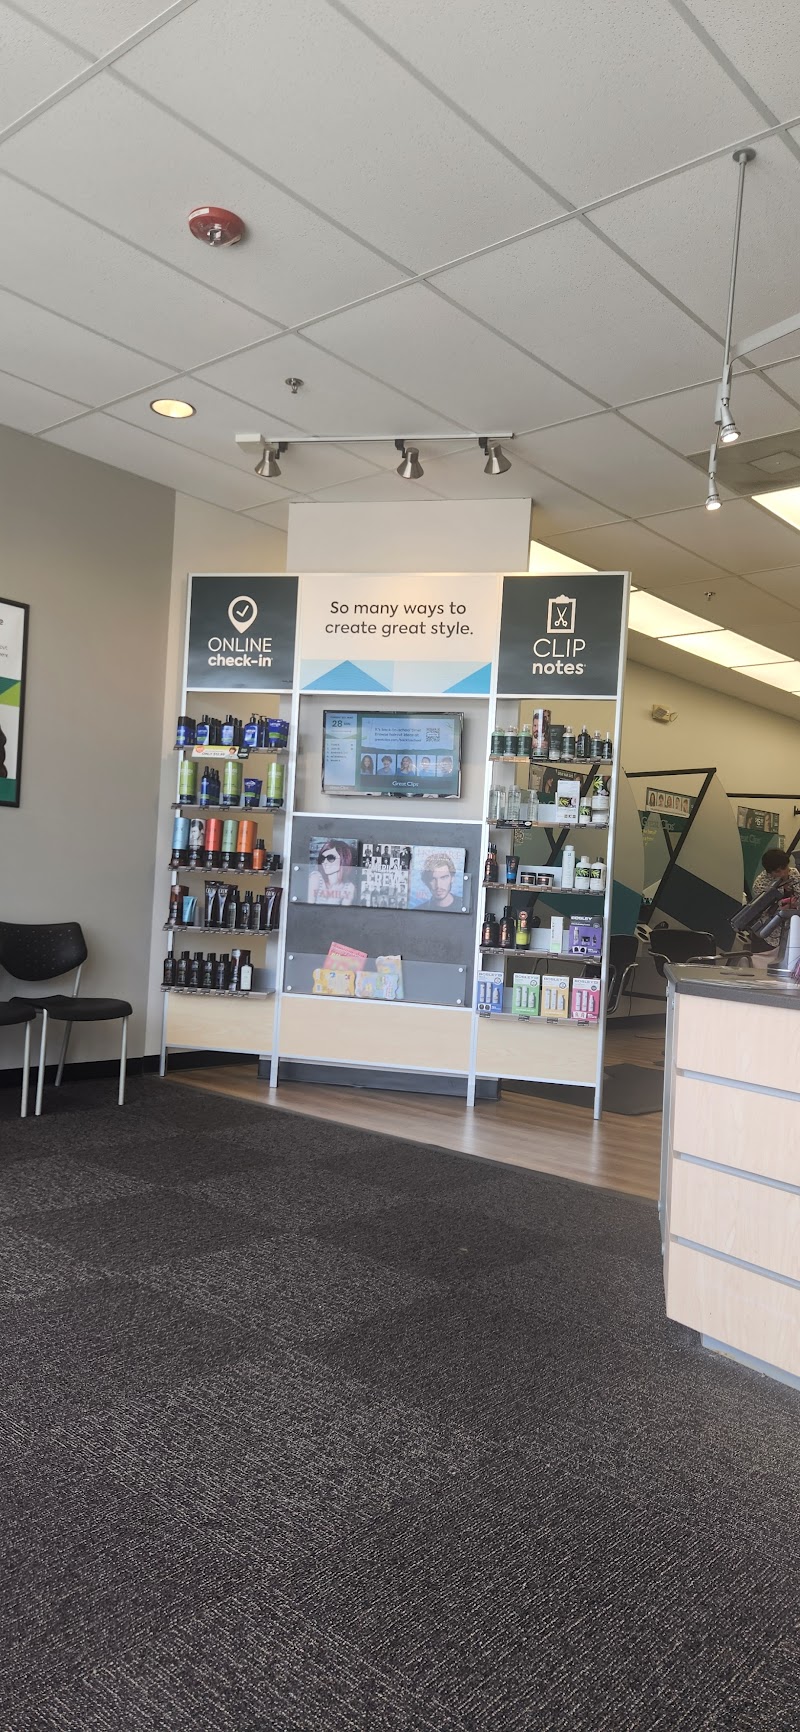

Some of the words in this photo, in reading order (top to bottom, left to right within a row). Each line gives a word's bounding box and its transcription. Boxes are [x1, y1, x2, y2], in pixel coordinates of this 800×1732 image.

[330, 601, 349, 614] So
[354, 603, 399, 617] many
[403, 603, 444, 617] ways
[450, 602, 467, 614] to
[325, 621, 377, 634] create
[381, 621, 426, 637] great
[431, 621, 474, 638] style.
[208, 637, 272, 653] ONLINE
[533, 638, 586, 657] CLIP
[208, 654, 272, 667] check-in
[532, 660, 585, 675] notes
[332, 719, 343, 728] 28
[366, 872, 403, 887] CREW
